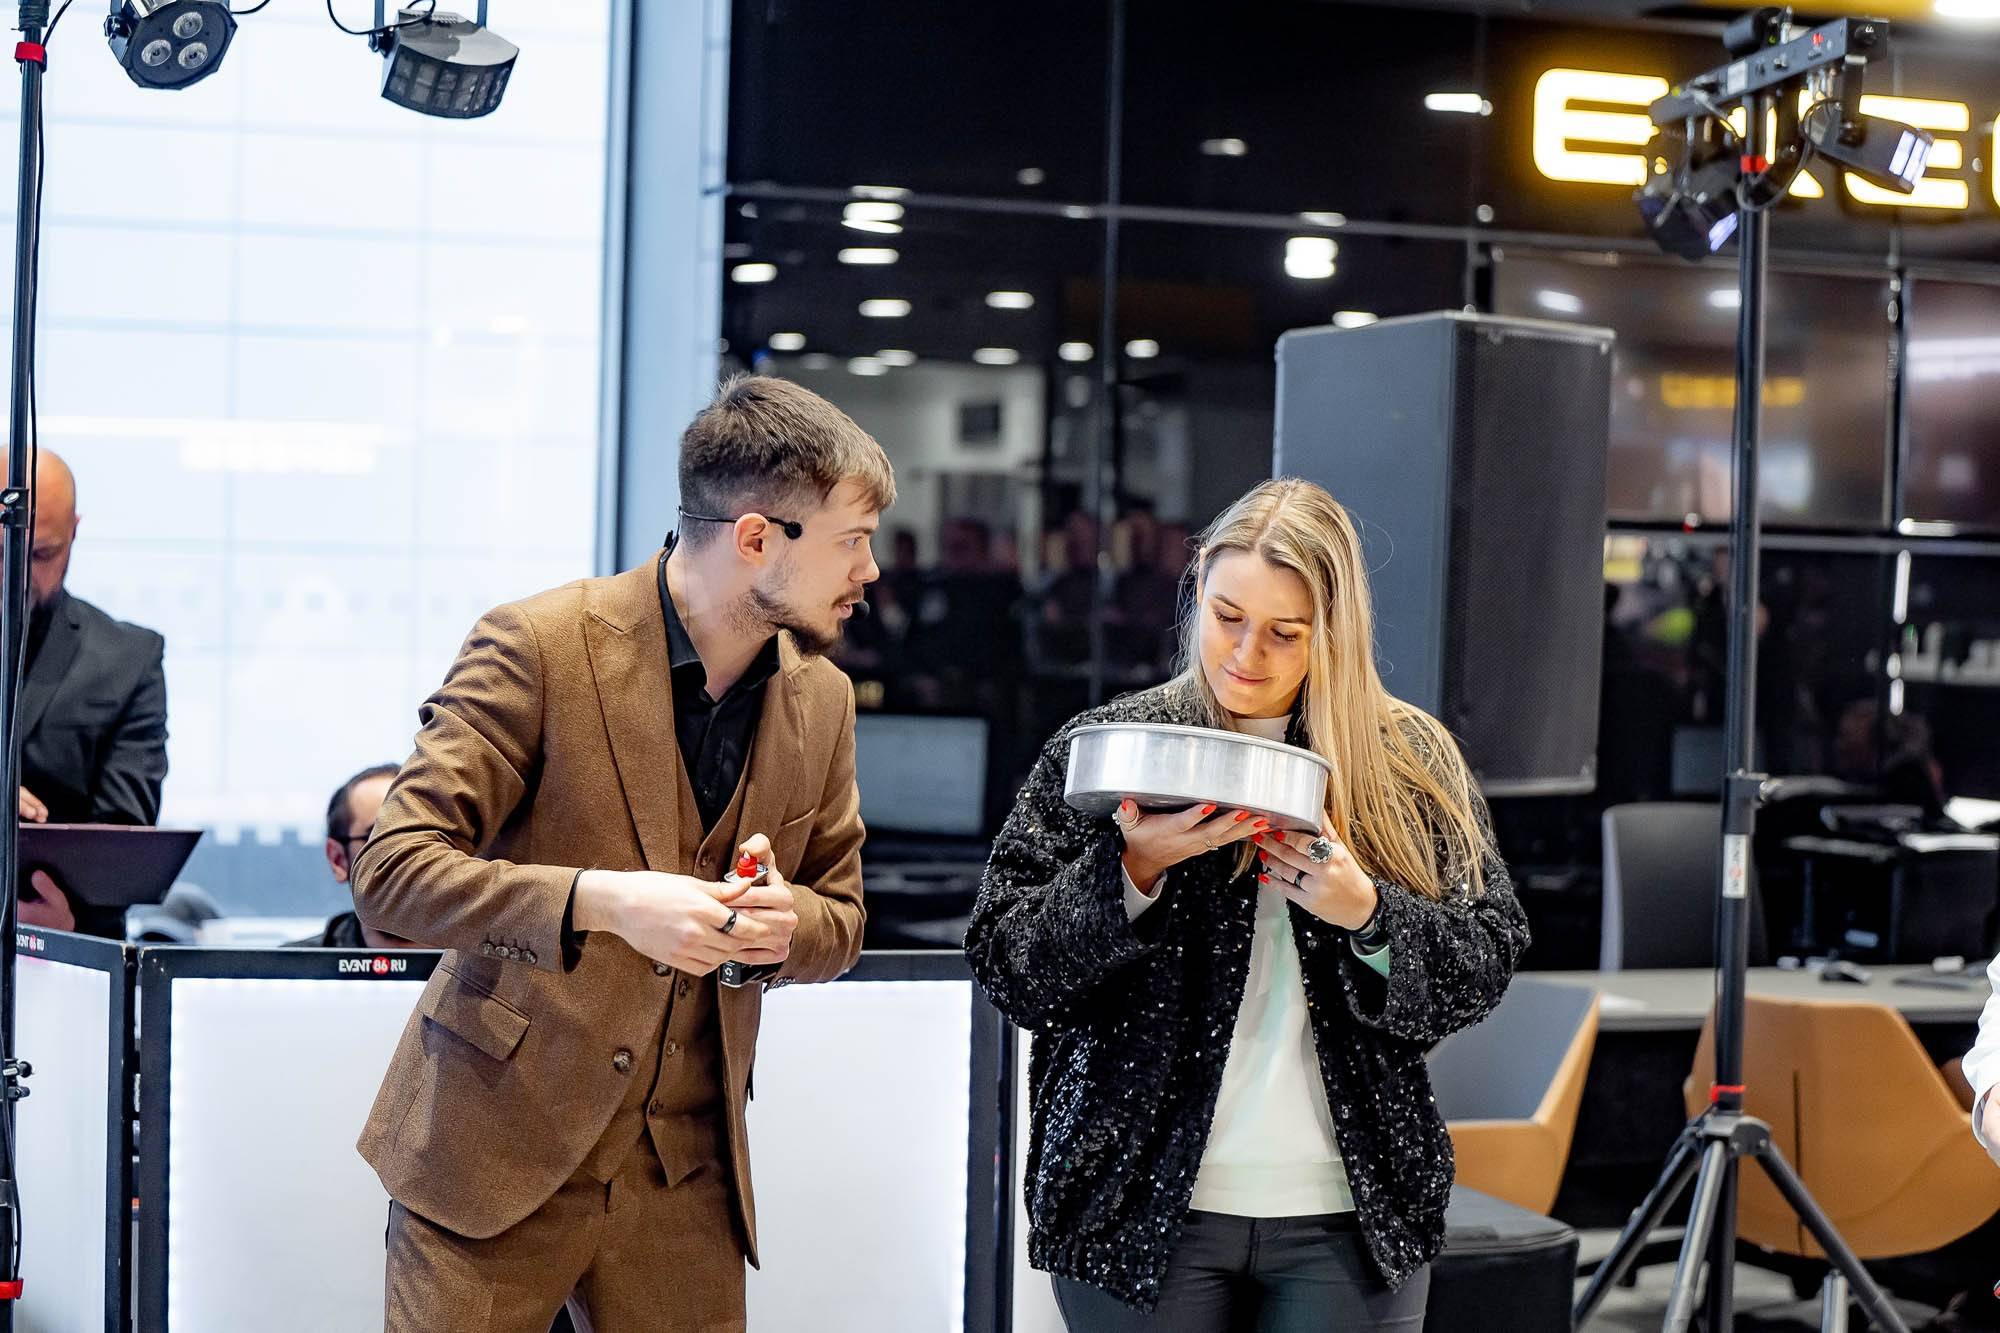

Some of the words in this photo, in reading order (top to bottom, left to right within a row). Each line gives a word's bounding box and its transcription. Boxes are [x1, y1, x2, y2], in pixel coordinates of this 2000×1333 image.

[37, 938, 45, 951] RU
[338, 959, 373, 973] EVENT
[373, 957, 389, 973] 86
[390, 959, 407, 973] RU
